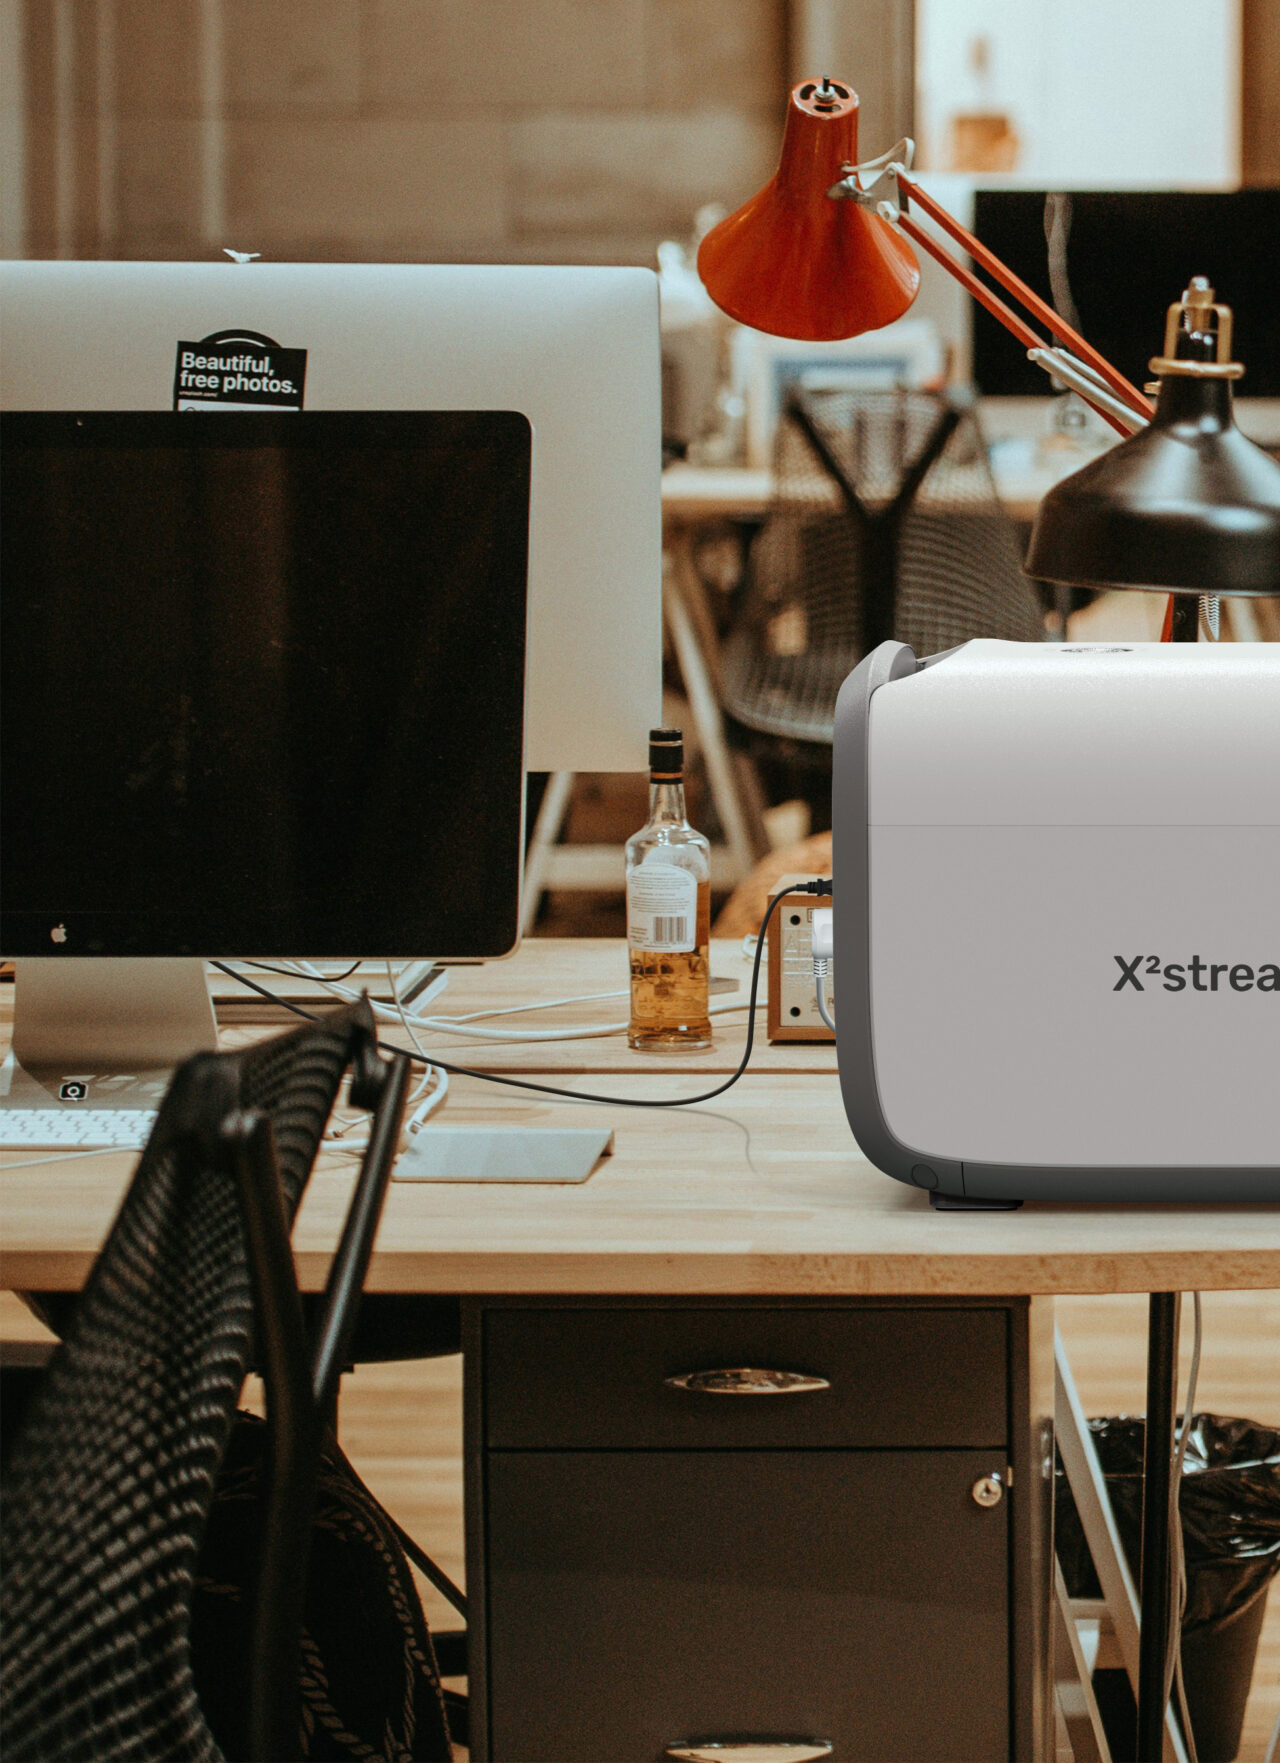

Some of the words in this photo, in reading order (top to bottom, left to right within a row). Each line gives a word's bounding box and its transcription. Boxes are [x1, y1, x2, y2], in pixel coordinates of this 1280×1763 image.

[181, 351, 275, 377] Beautiful,
[180, 369, 219, 389] free
[222, 373, 298, 394] photos.
